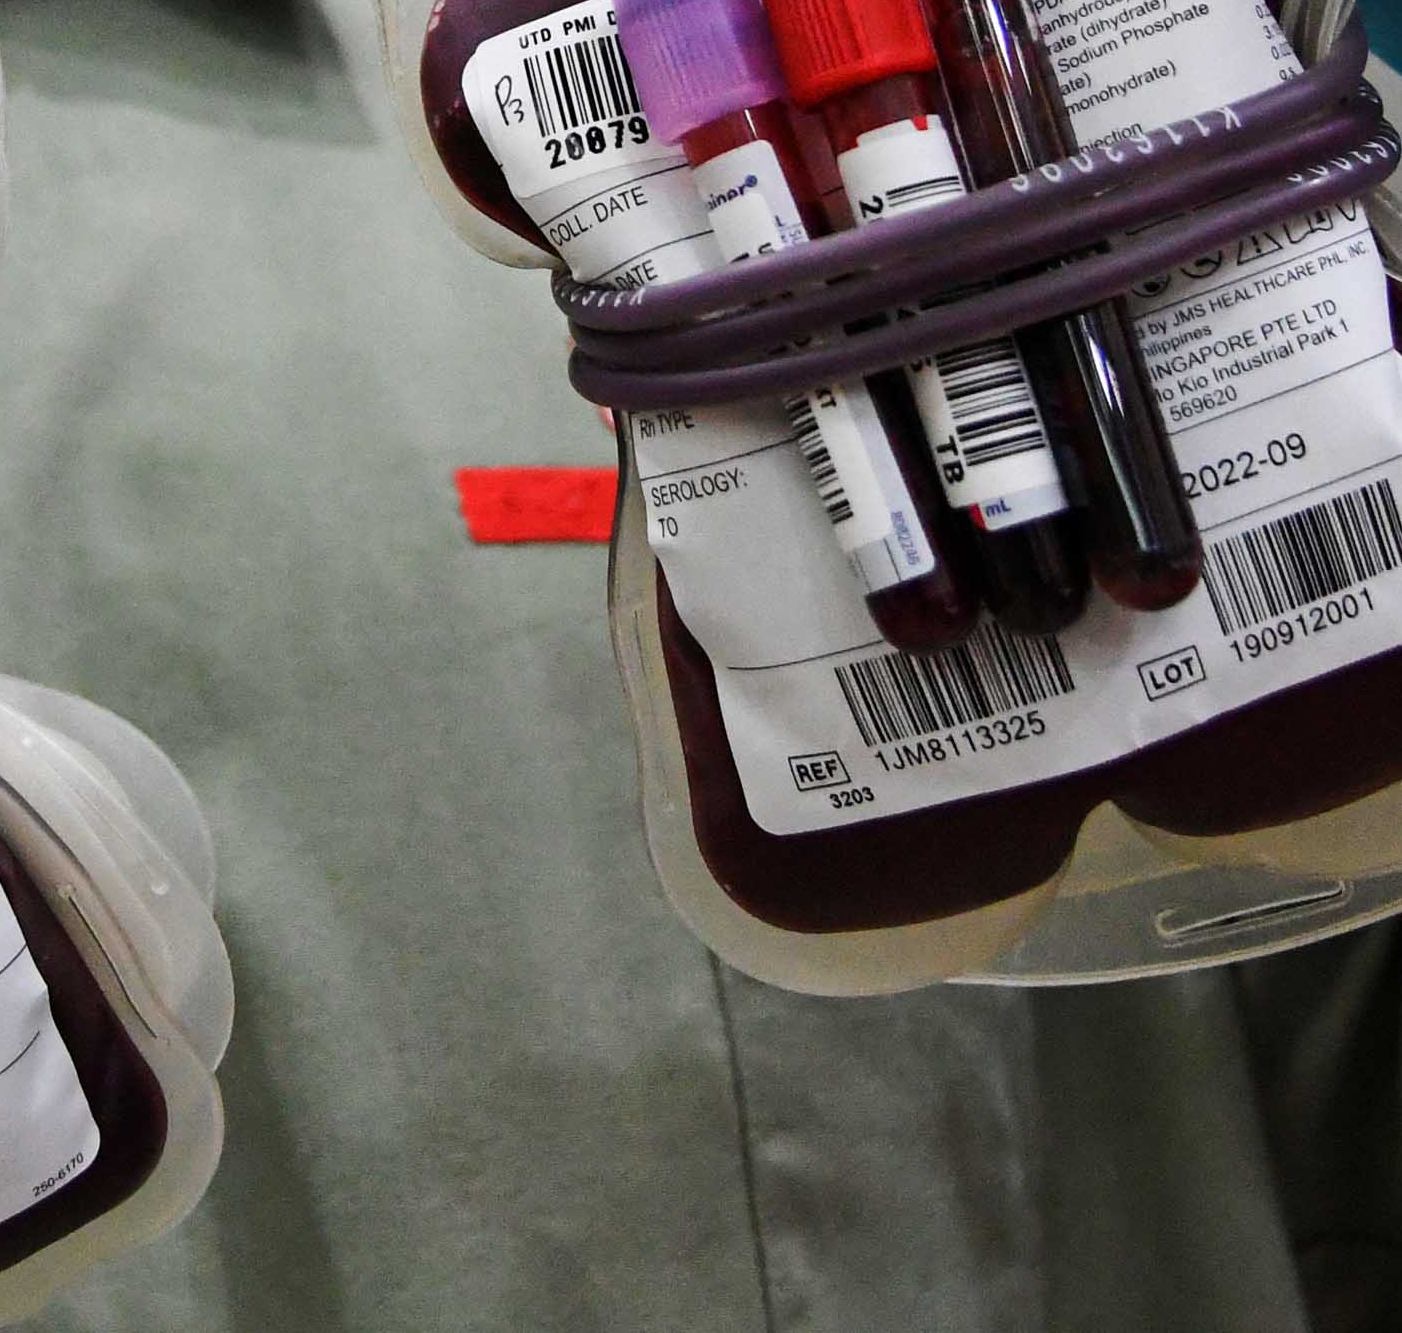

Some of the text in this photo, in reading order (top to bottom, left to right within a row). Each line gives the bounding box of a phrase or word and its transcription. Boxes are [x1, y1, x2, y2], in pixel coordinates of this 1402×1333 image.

[518, 27, 552, 49] UTD
[562, 15, 596, 36] PMI
[1057, 2, 1211, 74] Sodium Phosphate
[1066, 58, 1177, 116] monohydrate)
[544, 116, 650, 169] 20079
[549, 185, 649, 247] COLL. DATE
[1147, 319, 1168, 340] by
[1173, 302, 1207, 328] JMS
[1208, 260, 1318, 314] HEALTHCARE
[1320, 253, 1347, 271] PHL.
[1149, 297, 1338, 382] INGAPORE PTE LTD
[1211, 344, 1295, 384] Industrial
[1297, 323, 1337, 351] Park
[1169, 385, 1238, 423] 569620
[936, 435, 965, 485] TB
[1181, 432, 1307, 500] 2022-09
[651, 466, 749, 508] SEROLOGY:
[985, 497, 1012, 518] mL
[658, 516, 679, 539] TO
[1230, 587, 1375, 664] 190912001
[1149, 656, 1195, 691] LOT
[874, 710, 1047, 773] 1JM8113325
[795, 758, 839, 784] REF
[829, 786, 876, 809] 3203
[32, 1152, 85, 1198] 250-6170
